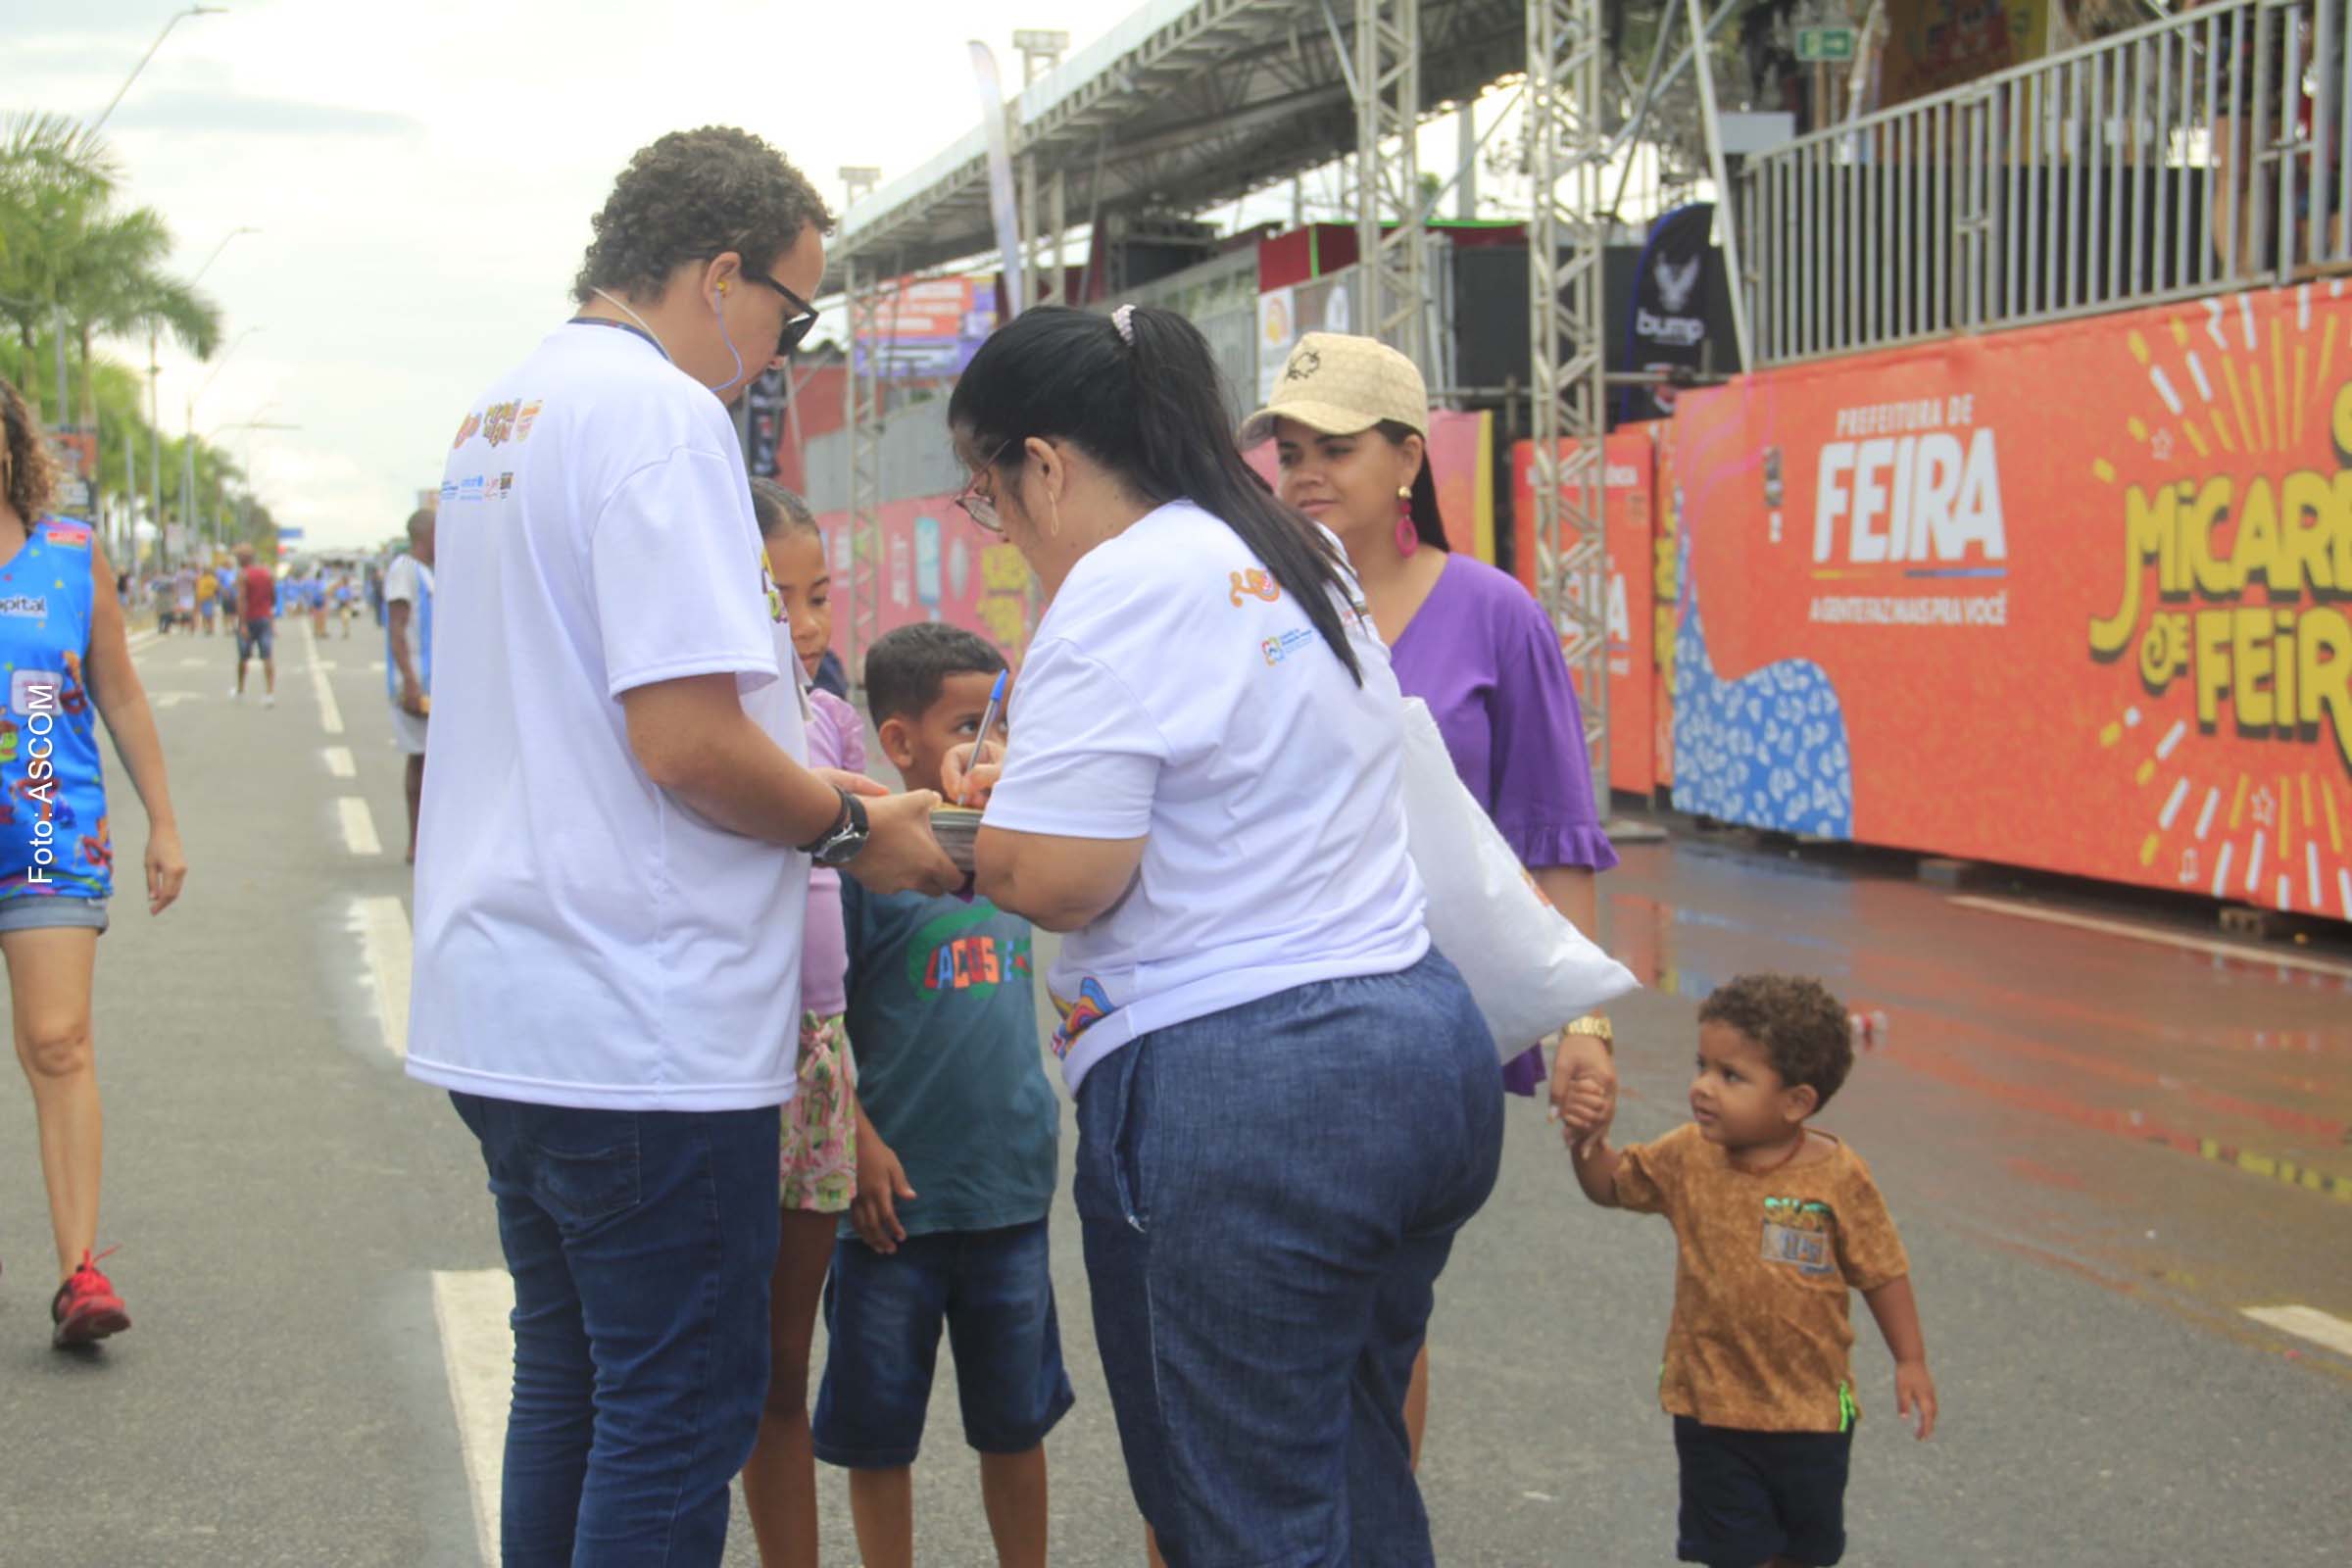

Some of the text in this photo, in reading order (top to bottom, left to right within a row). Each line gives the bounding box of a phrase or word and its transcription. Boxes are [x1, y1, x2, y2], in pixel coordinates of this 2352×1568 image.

[1637, 307, 1704, 345] bump
[1836, 393, 1974, 437] PREFEITURA DE
[1813, 427, 2006, 564] FEIRA
